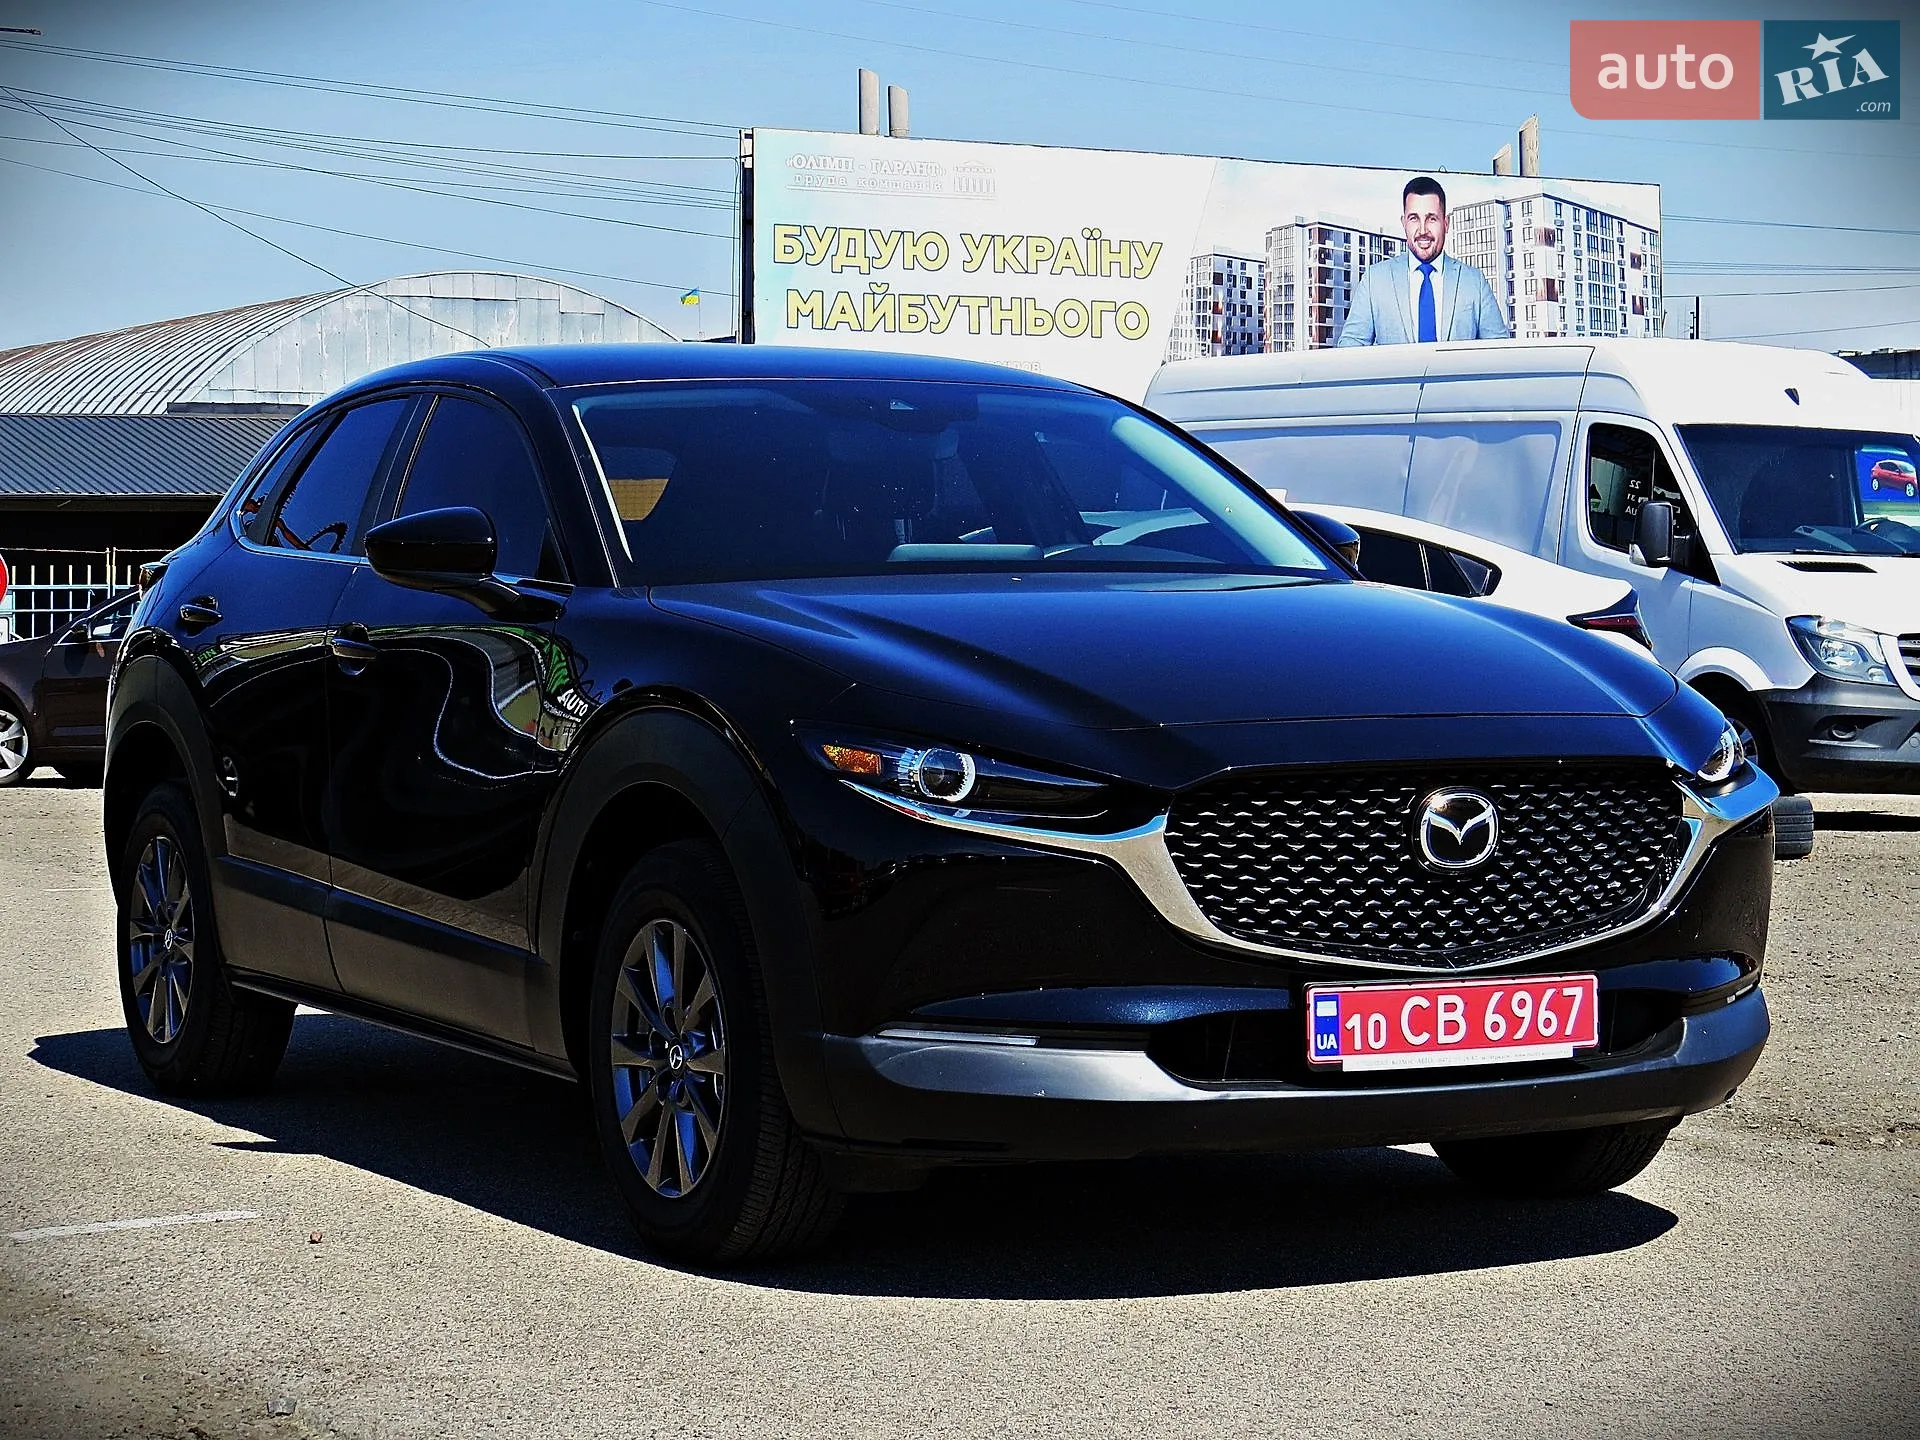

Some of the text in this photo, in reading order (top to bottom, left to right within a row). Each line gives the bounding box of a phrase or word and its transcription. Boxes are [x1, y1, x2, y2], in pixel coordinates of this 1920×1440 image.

[794, 173, 848, 188] група
[773, 223, 1163, 280] БУДУЮ УКРАЇНУ
[786, 281, 1150, 341] МАЙБУТНЬОГО
[556, 688, 588, 717] AUTO
[1344, 986, 1583, 1051] 10 CB 6967
[1316, 1033, 1338, 1050] UA
